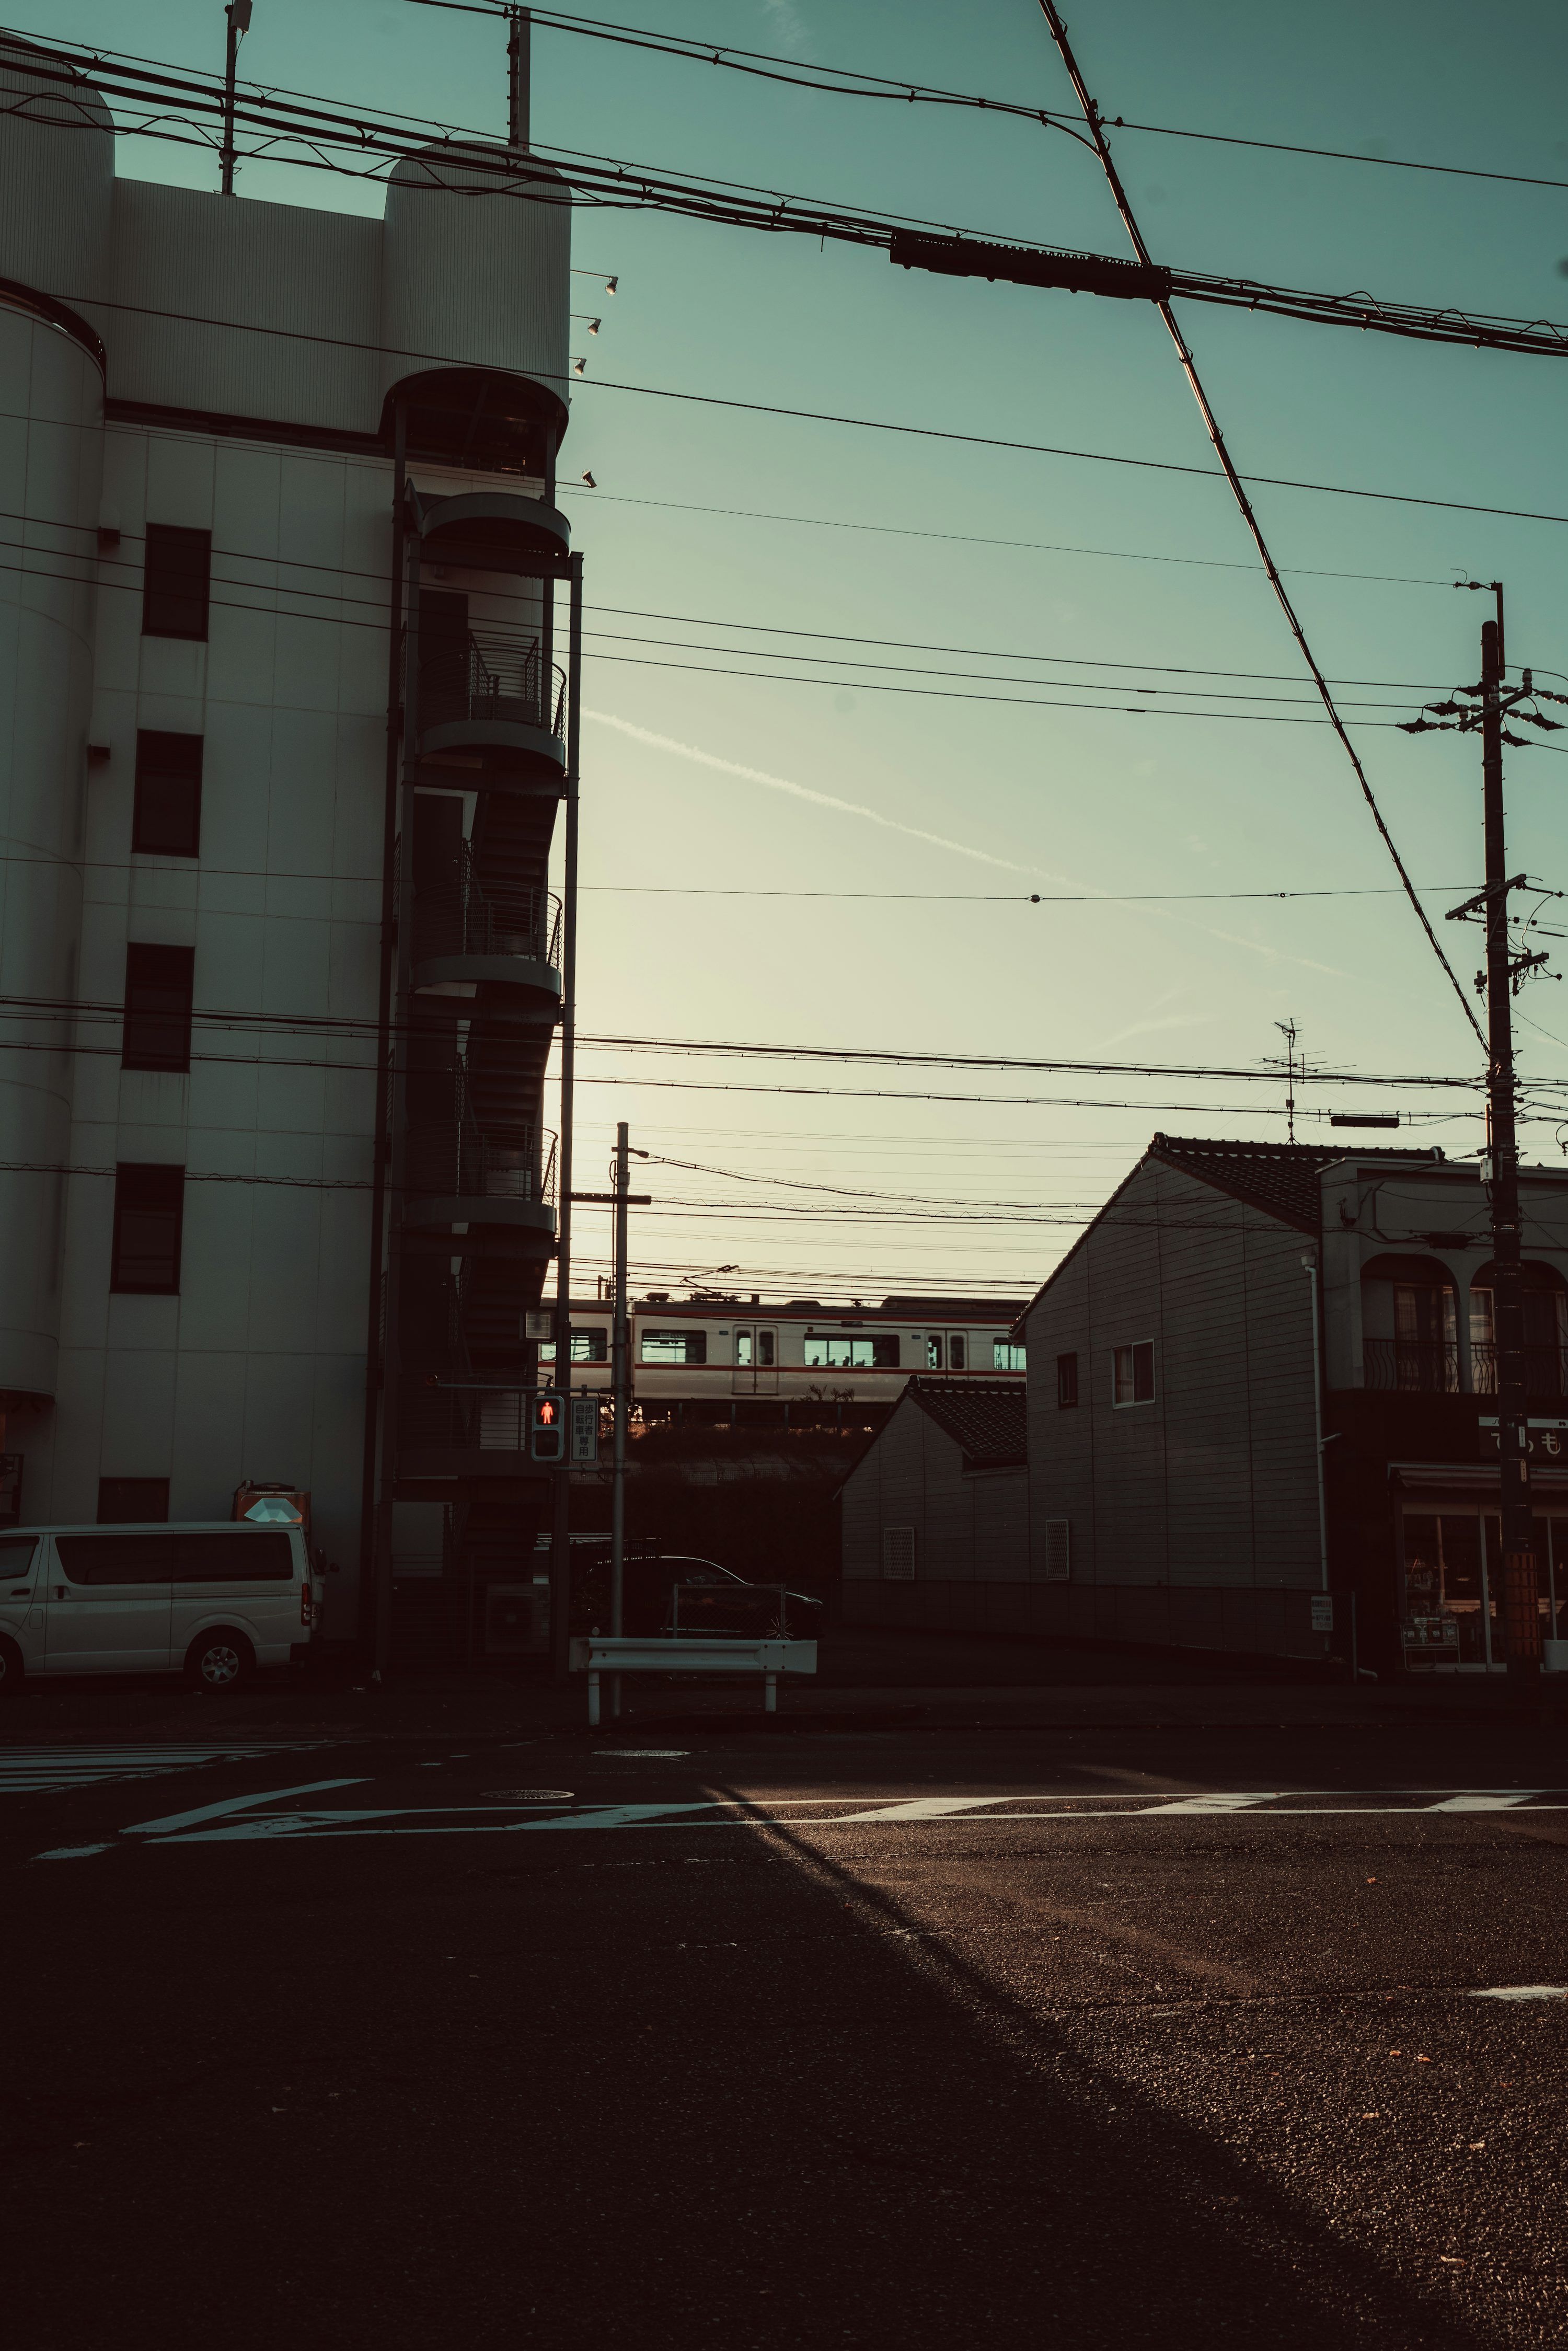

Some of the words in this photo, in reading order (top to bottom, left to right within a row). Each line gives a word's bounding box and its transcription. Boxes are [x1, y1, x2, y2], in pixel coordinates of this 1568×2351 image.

[575, 1404, 584, 1435] 自転車
[584, 1404, 594, 1435] 歩行者
[579, 1436, 589, 1456] 専用
